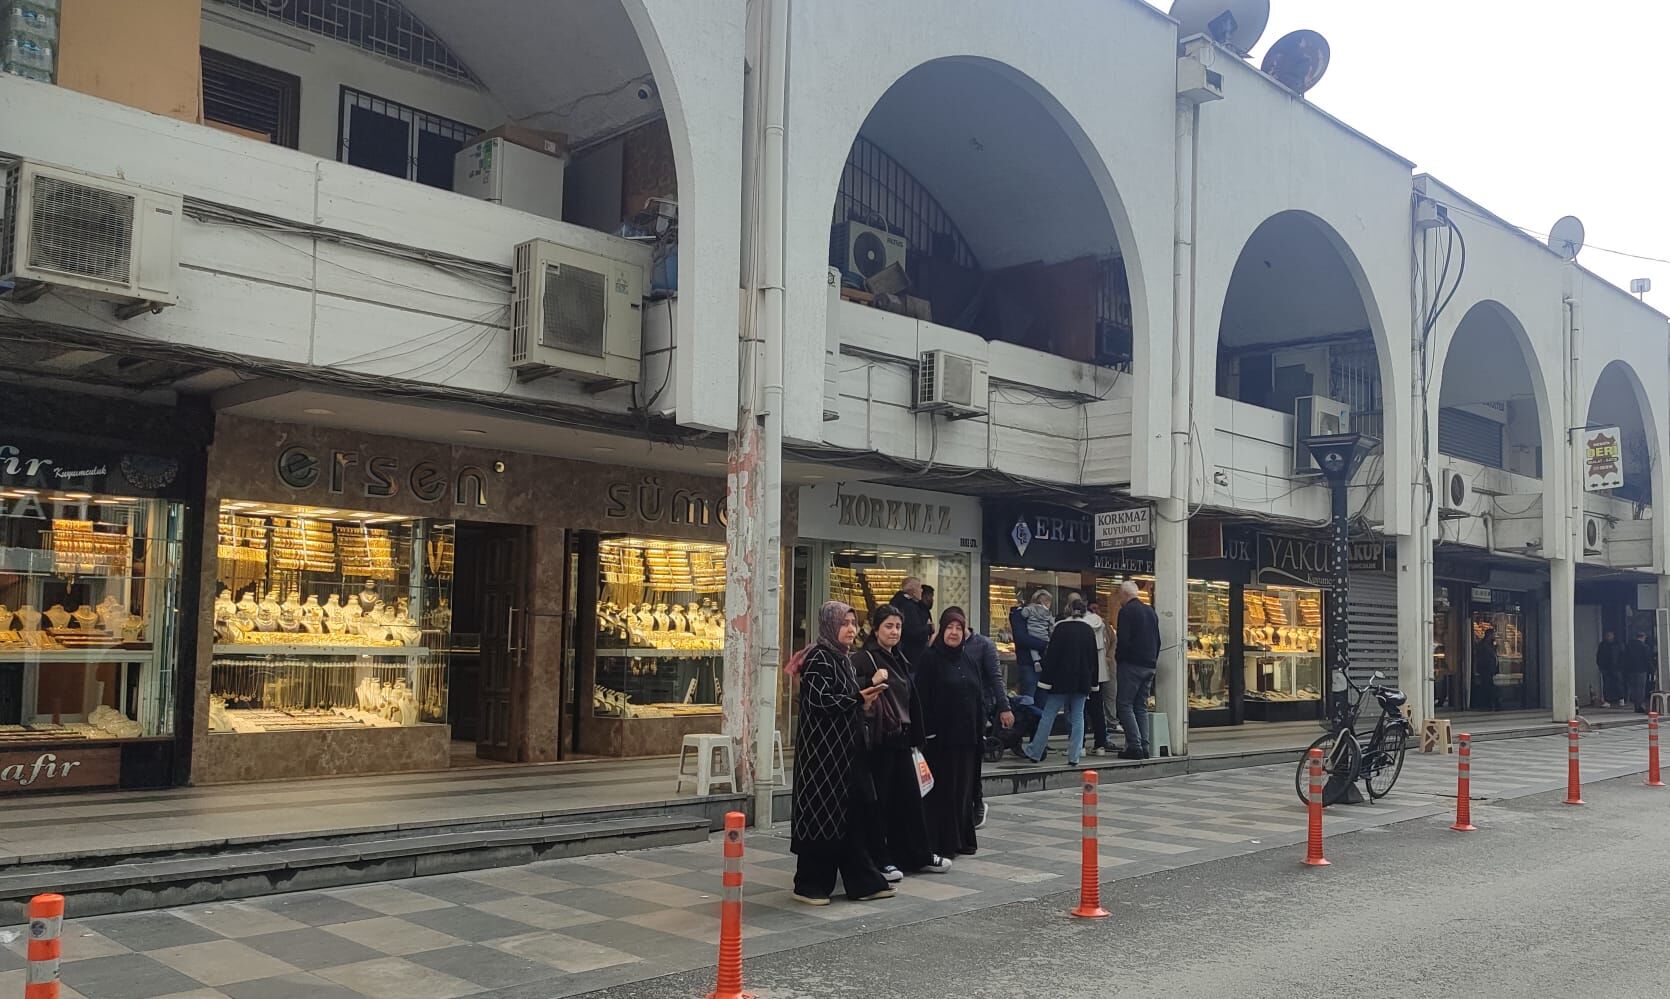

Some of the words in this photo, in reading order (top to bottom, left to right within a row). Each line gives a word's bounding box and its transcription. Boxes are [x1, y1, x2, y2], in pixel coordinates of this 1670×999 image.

[839, 493, 951, 535] KORKMAZ
[1098, 510, 1147, 526] KORKMAZ
[1035, 515, 1091, 544] ERTÜ
[1102, 524, 1141, 536] KUYUMCU
[1094, 555, 1143, 571] MEHMET
[1267, 538, 1331, 573] YAKU
[0, 753, 81, 785] afir
